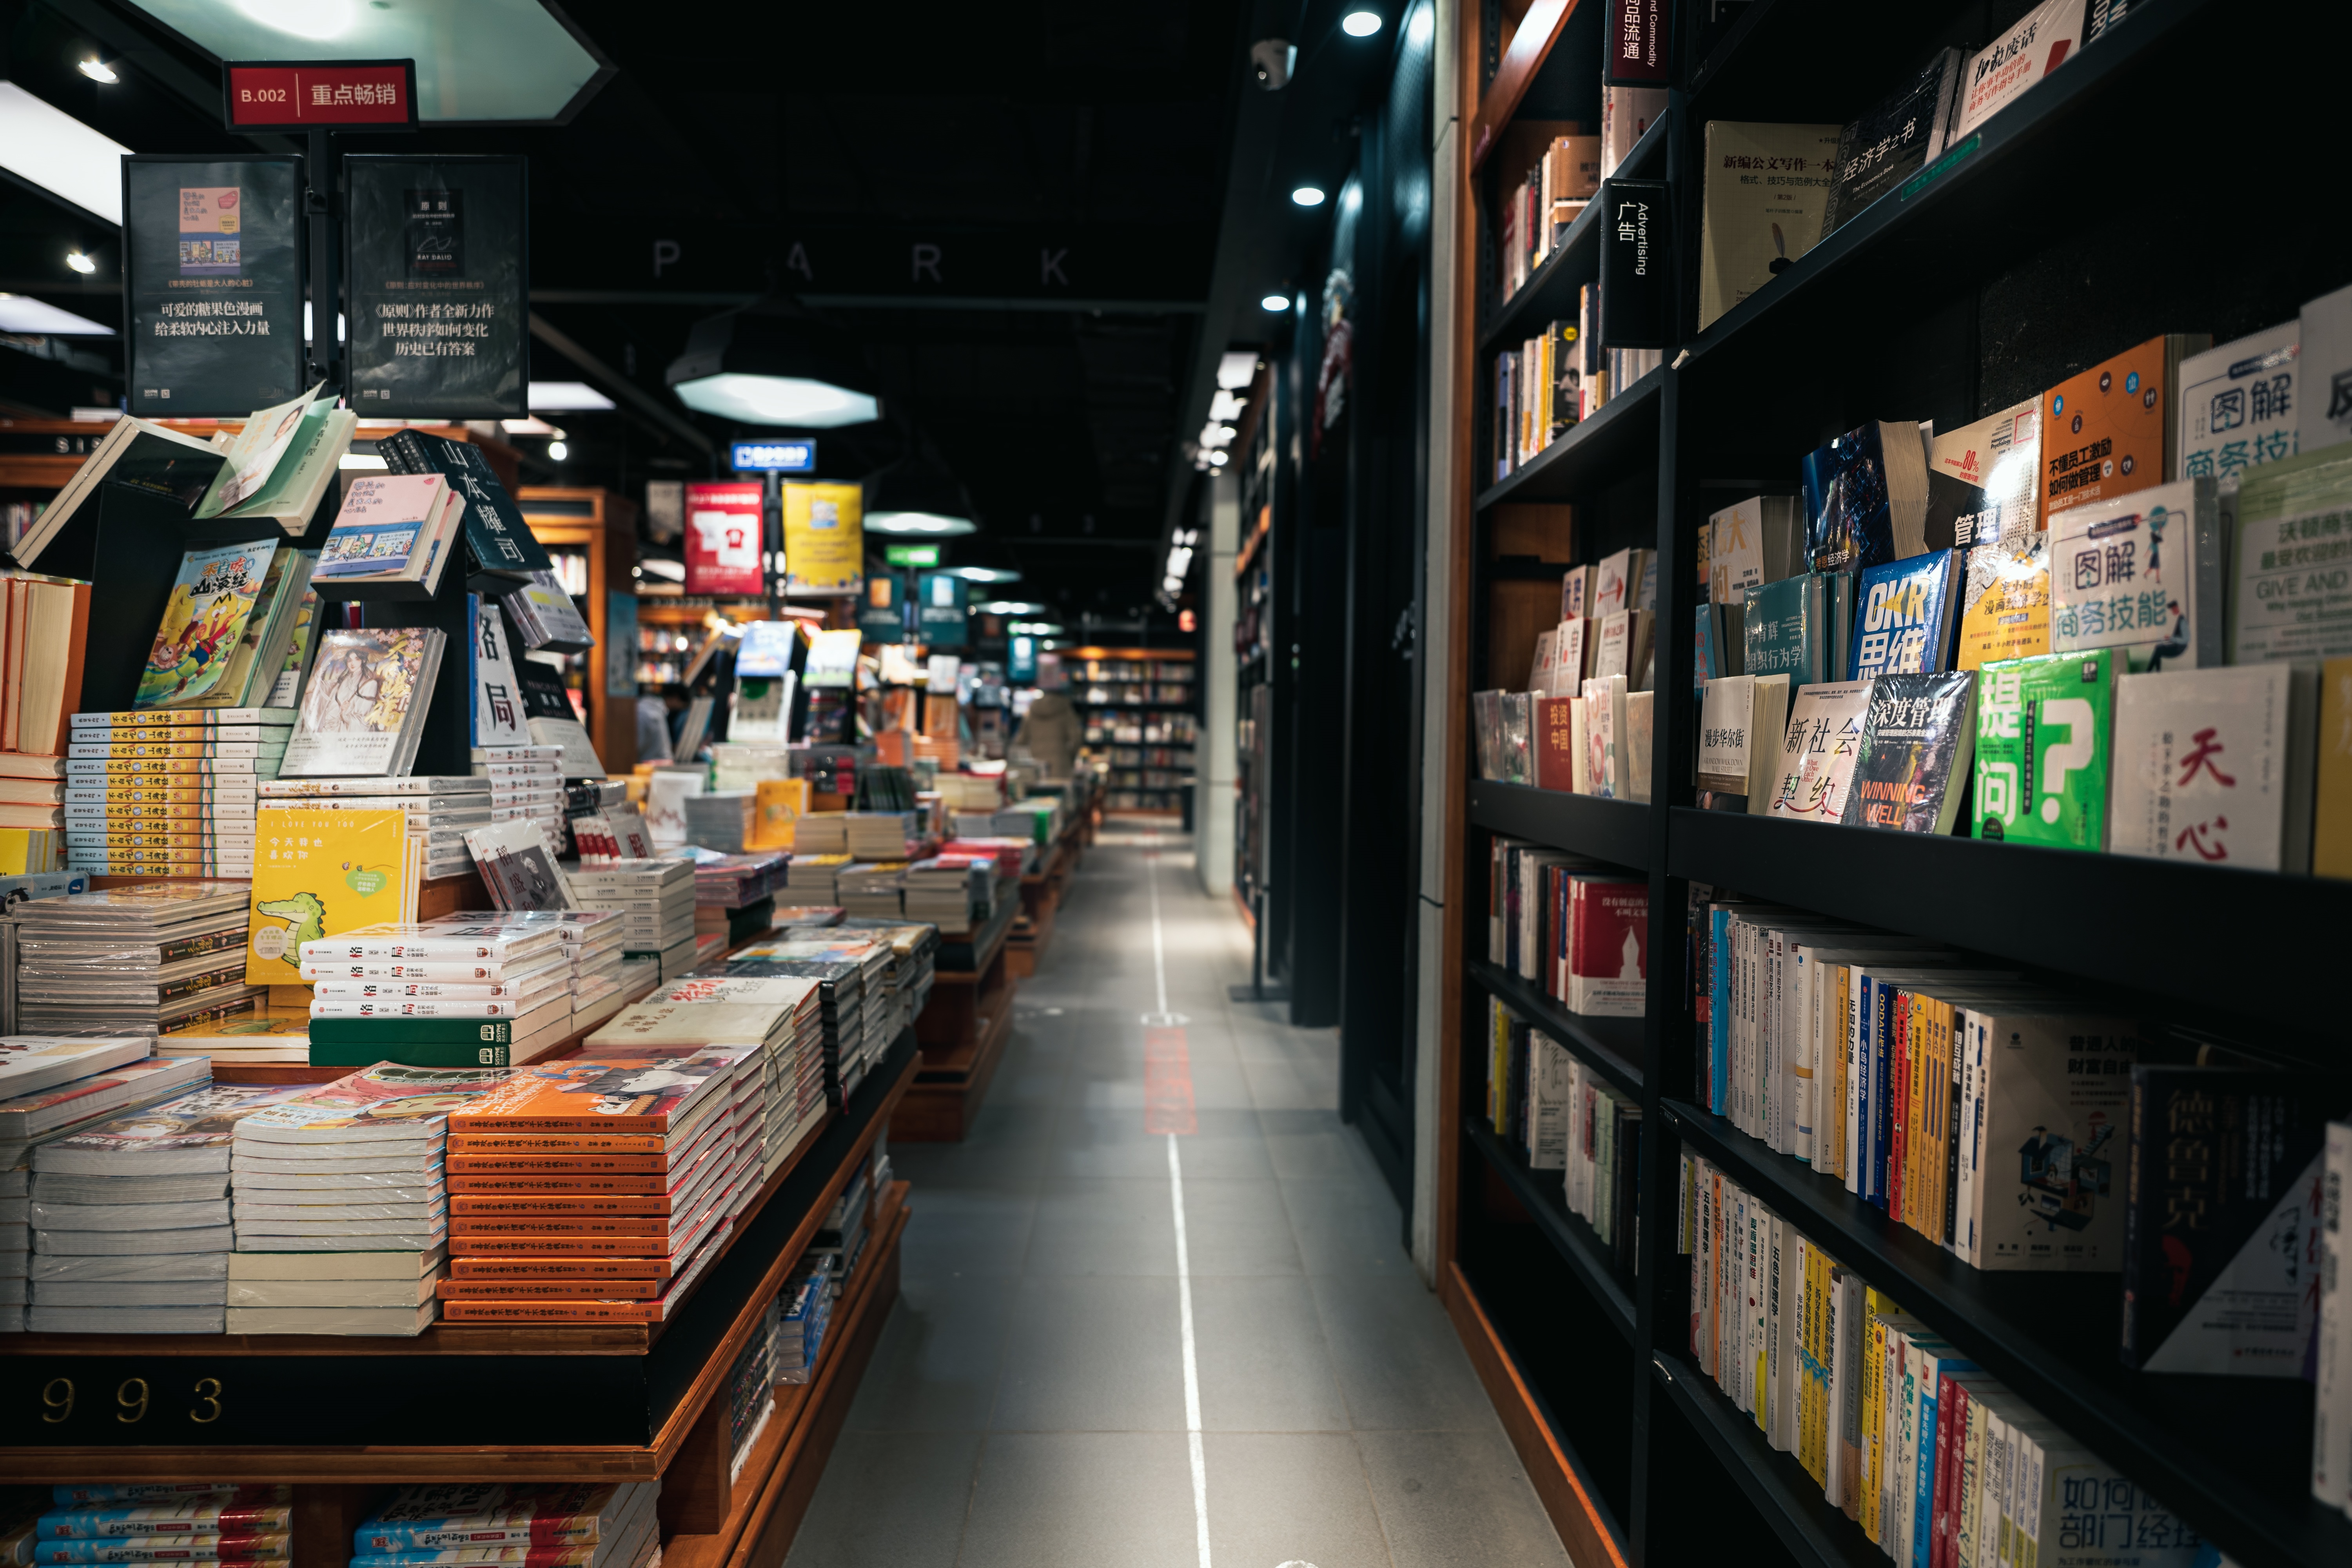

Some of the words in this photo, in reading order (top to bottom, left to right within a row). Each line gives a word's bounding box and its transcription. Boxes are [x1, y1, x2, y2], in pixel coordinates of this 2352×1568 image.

[1648, 15, 1659, 67] Commodity
[1969, 60, 2032, 113] 商务写作指导手册
[1971, 53, 2026, 99] 让你事半功倍的
[241, 89, 287, 103] B.002
[311, 83, 396, 107] 重点畅销
[1723, 155, 1835, 173] 新编公文写作一本
[1842, 117, 1917, 183] 经济学之书
[1740, 175, 1831, 188] 格式、技巧与范例大全
[1852, 186, 1861, 194] The
[1862, 172, 1883, 190] Economics
[1884, 164, 1895, 174] Book
[1618, 201, 1637, 241] 广告
[1636, 202, 1649, 275] Advertising
[160, 301, 263, 318] 可爱的糖果色漫画
[374, 303, 495, 319] 《原则》作者全新力作
[154, 319, 270, 337] 给柔软内心注入力量
[382, 322, 489, 338] 世界秩序如何变化
[394, 341, 475, 357] 历史已有答案
[1962, 450, 1979, 472] 80%
[2049, 436, 2112, 477] 不懂员工激励
[2049, 463, 2101, 498] 如何做管理
[1954, 508, 1998, 546] 管理
[1815, 550, 1850, 569] 考恩经济学
[2074, 540, 2136, 591] 图解
[1864, 575, 1930, 634] OKR
[2055, 590, 2167, 640] 商务技能
[1745, 646, 1801, 672] 组织行为学
[1857, 628, 1924, 679] 思维
[1550, 705, 1568, 726] 投资
[1872, 697, 1953, 728] 深度管理
[1550, 728, 1568, 750] 中国
[1705, 728, 1744, 748] 漫步华尔街
[1786, 718, 1860, 757] 新社会
[1975, 672, 2021, 826] 提问
[1779, 773, 1836, 815] 契约
[1860, 780, 1926, 804] WINNING
[2176, 728, 2236, 861] 天心
[1866, 803, 1902, 826] WELL
[269, 837, 323, 847] 今天我也
[269, 850, 309, 860] 喜欢你
[350, 946, 363, 958] 格
[392, 946, 405, 958] 局
[351, 966, 364, 978] 格
[392, 966, 404, 978] 局
[364, 984, 377, 997] 格
[405, 984, 418, 996] 局
[360, 1004, 373, 1016] 格
[402, 1004, 415, 1016] 局
[1847, 999, 1856, 1065] 无知的力量
[2069, 1034, 2136, 1053] 普通人的
[1859, 1039, 1867, 1101] 小岛经济学
[2067, 1058, 2134, 1075] 财富自由
[1749, 1217, 1757, 1280] 麦肯锡思维
[1771, 1246, 1780, 1316] 五色管理学
[1804, 1281, 1812, 1351] 拆穿数据胡扯
[1813, 1287, 1821, 1360] 拆穿数据胡扯
[1865, 1301, 1875, 1355] 快读大师
[2060, 1514, 2202, 1549] 部门经理
